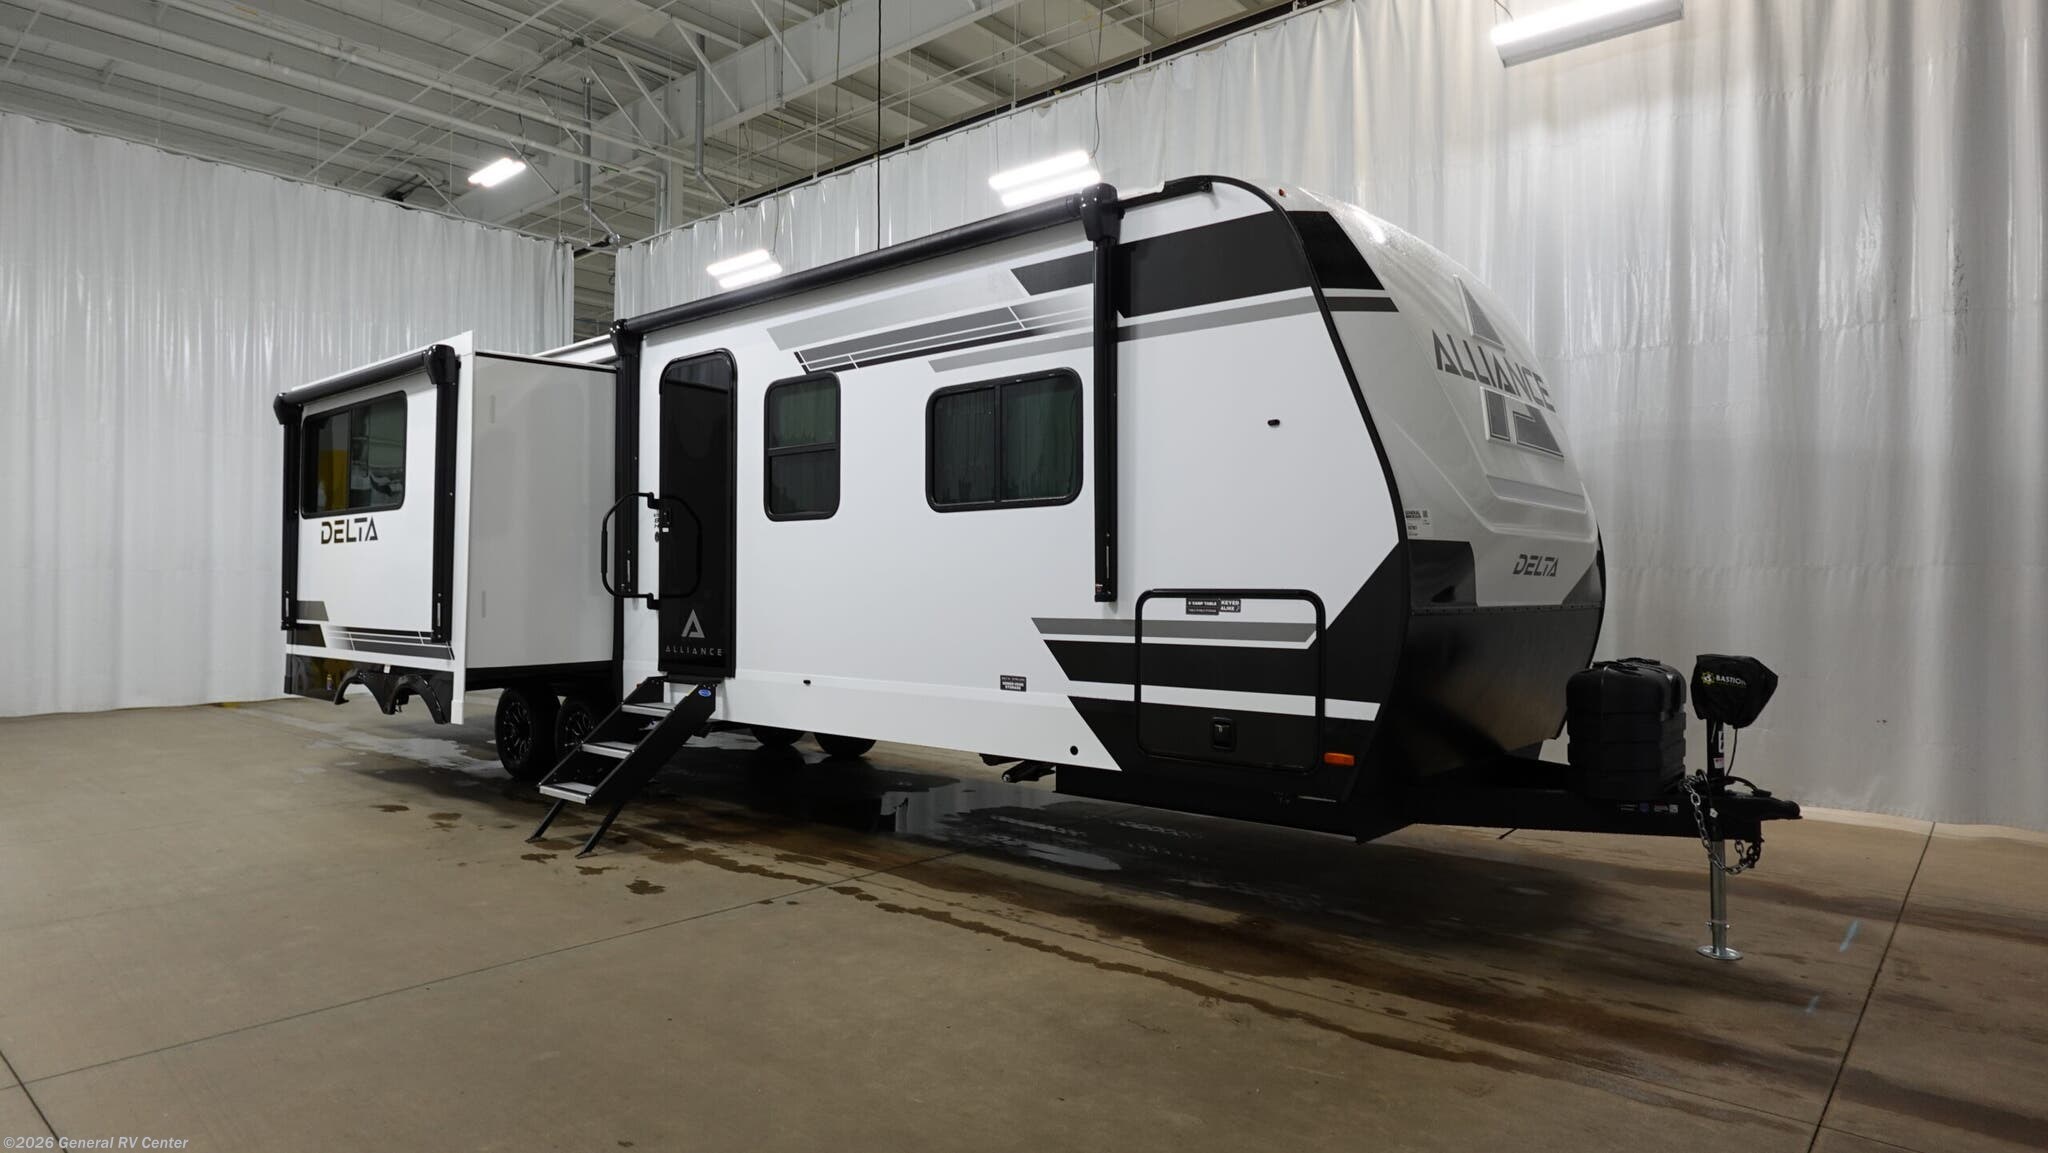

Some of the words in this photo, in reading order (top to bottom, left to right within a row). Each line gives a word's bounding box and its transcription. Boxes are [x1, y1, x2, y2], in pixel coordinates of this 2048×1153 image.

[1432, 329, 1556, 413] ALLIANCE
[321, 516, 378, 544] DELTA
[1512, 554, 1559, 577] DELTA
[665, 645, 722, 656] ALLIANCE
